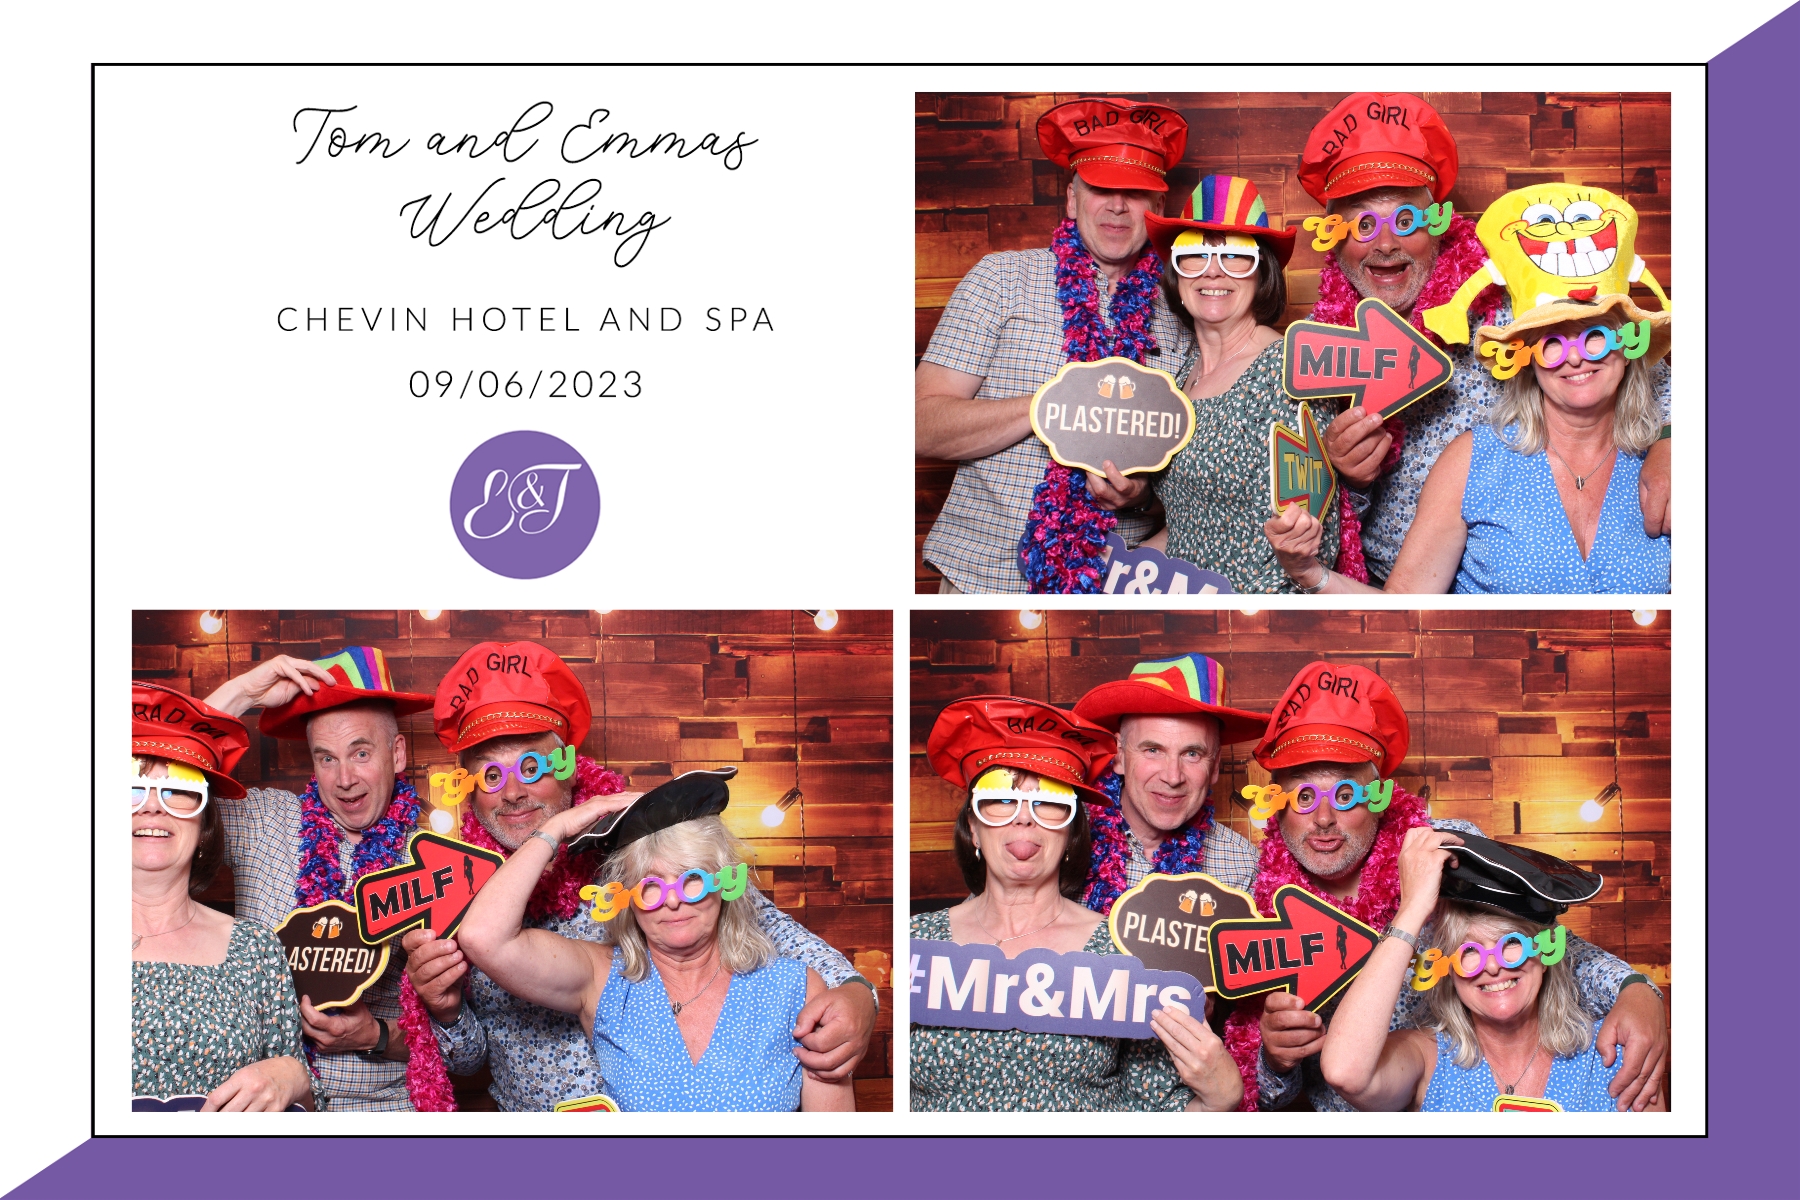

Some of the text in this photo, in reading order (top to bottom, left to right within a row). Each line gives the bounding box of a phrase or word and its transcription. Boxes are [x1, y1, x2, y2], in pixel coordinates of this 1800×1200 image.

[1074, 109, 1168, 137] BAD GIRL
[1367, 102, 1410, 131] GIRL
[1299, 343, 1398, 380] MILF
[1044, 403, 1181, 439] PLASTERED!
[1284, 452, 1323, 494] TWIT
[487, 653, 532, 678] GIRL
[1317, 671, 1360, 704] GIRL
[368, 865, 454, 922] MILF
[1123, 911, 1210, 954] PLASTE
[283, 945, 376, 974] ASTERED!
[1225, 932, 1325, 976] MILF
